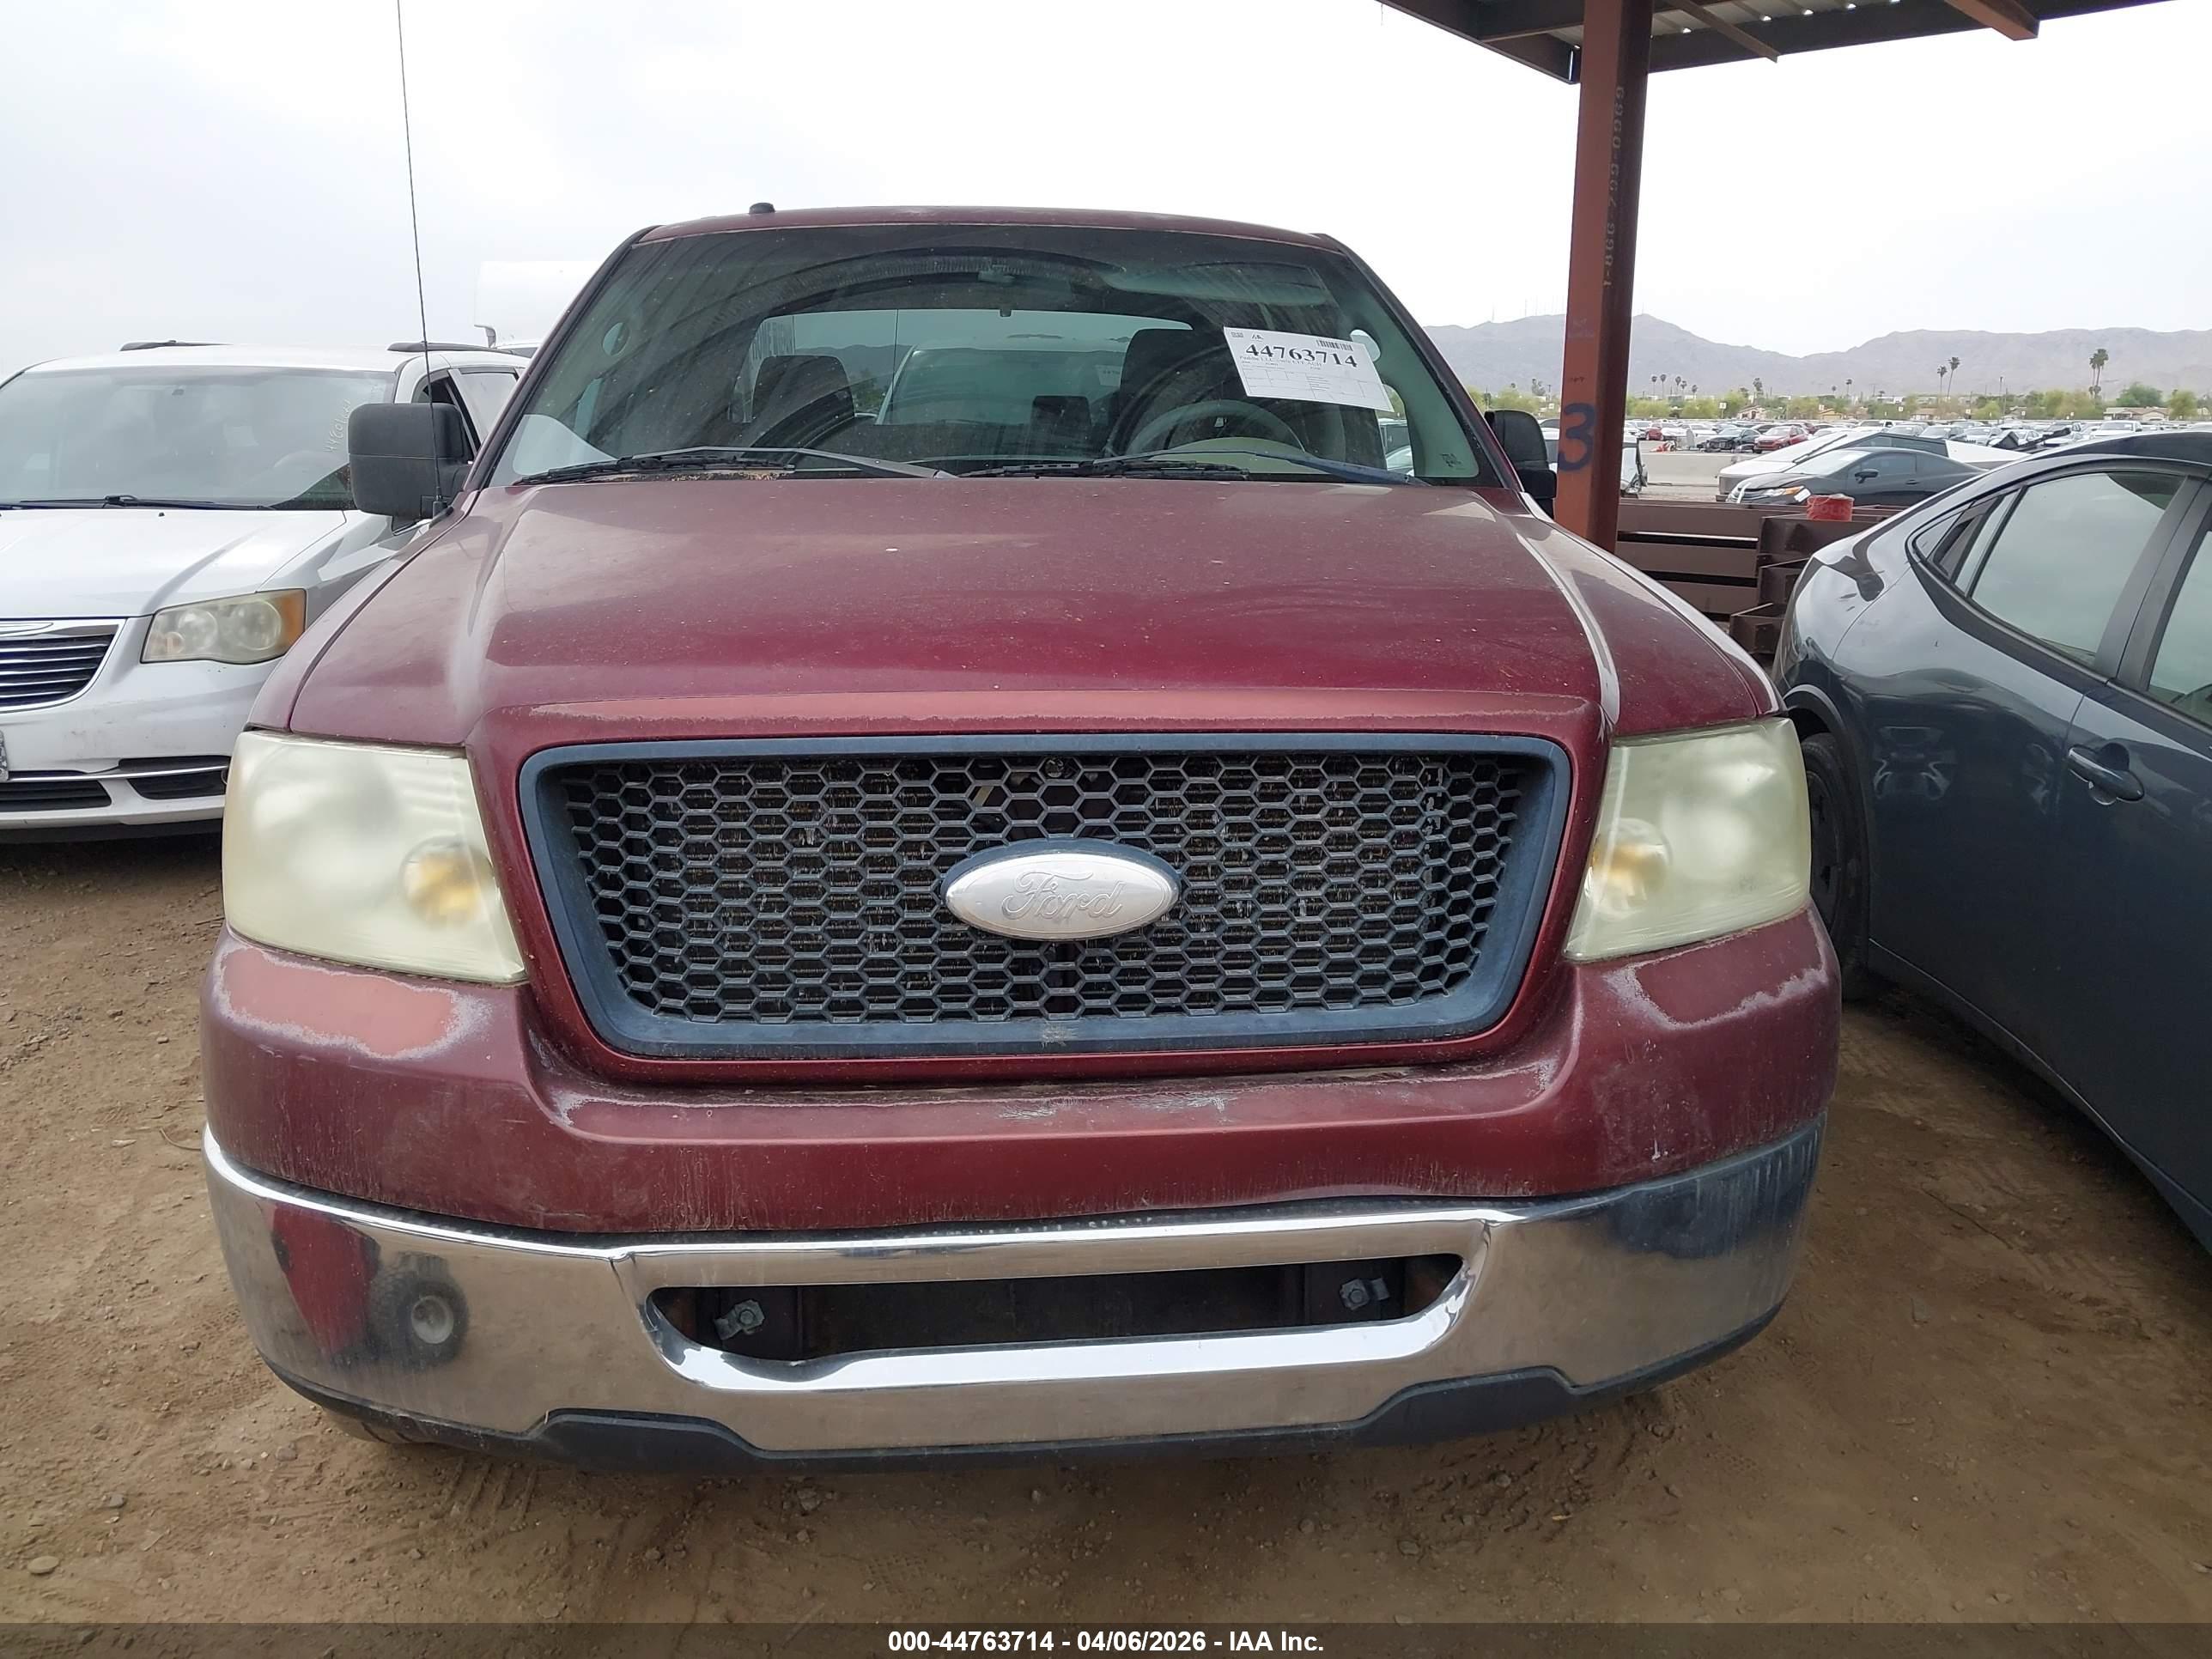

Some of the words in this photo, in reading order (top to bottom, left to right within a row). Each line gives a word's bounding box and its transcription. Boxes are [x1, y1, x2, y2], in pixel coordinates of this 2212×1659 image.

[1245, 343, 1358, 368] 44763714
[1558, 401, 1595, 471] 3
[1000, 871, 1126, 920] Ford
